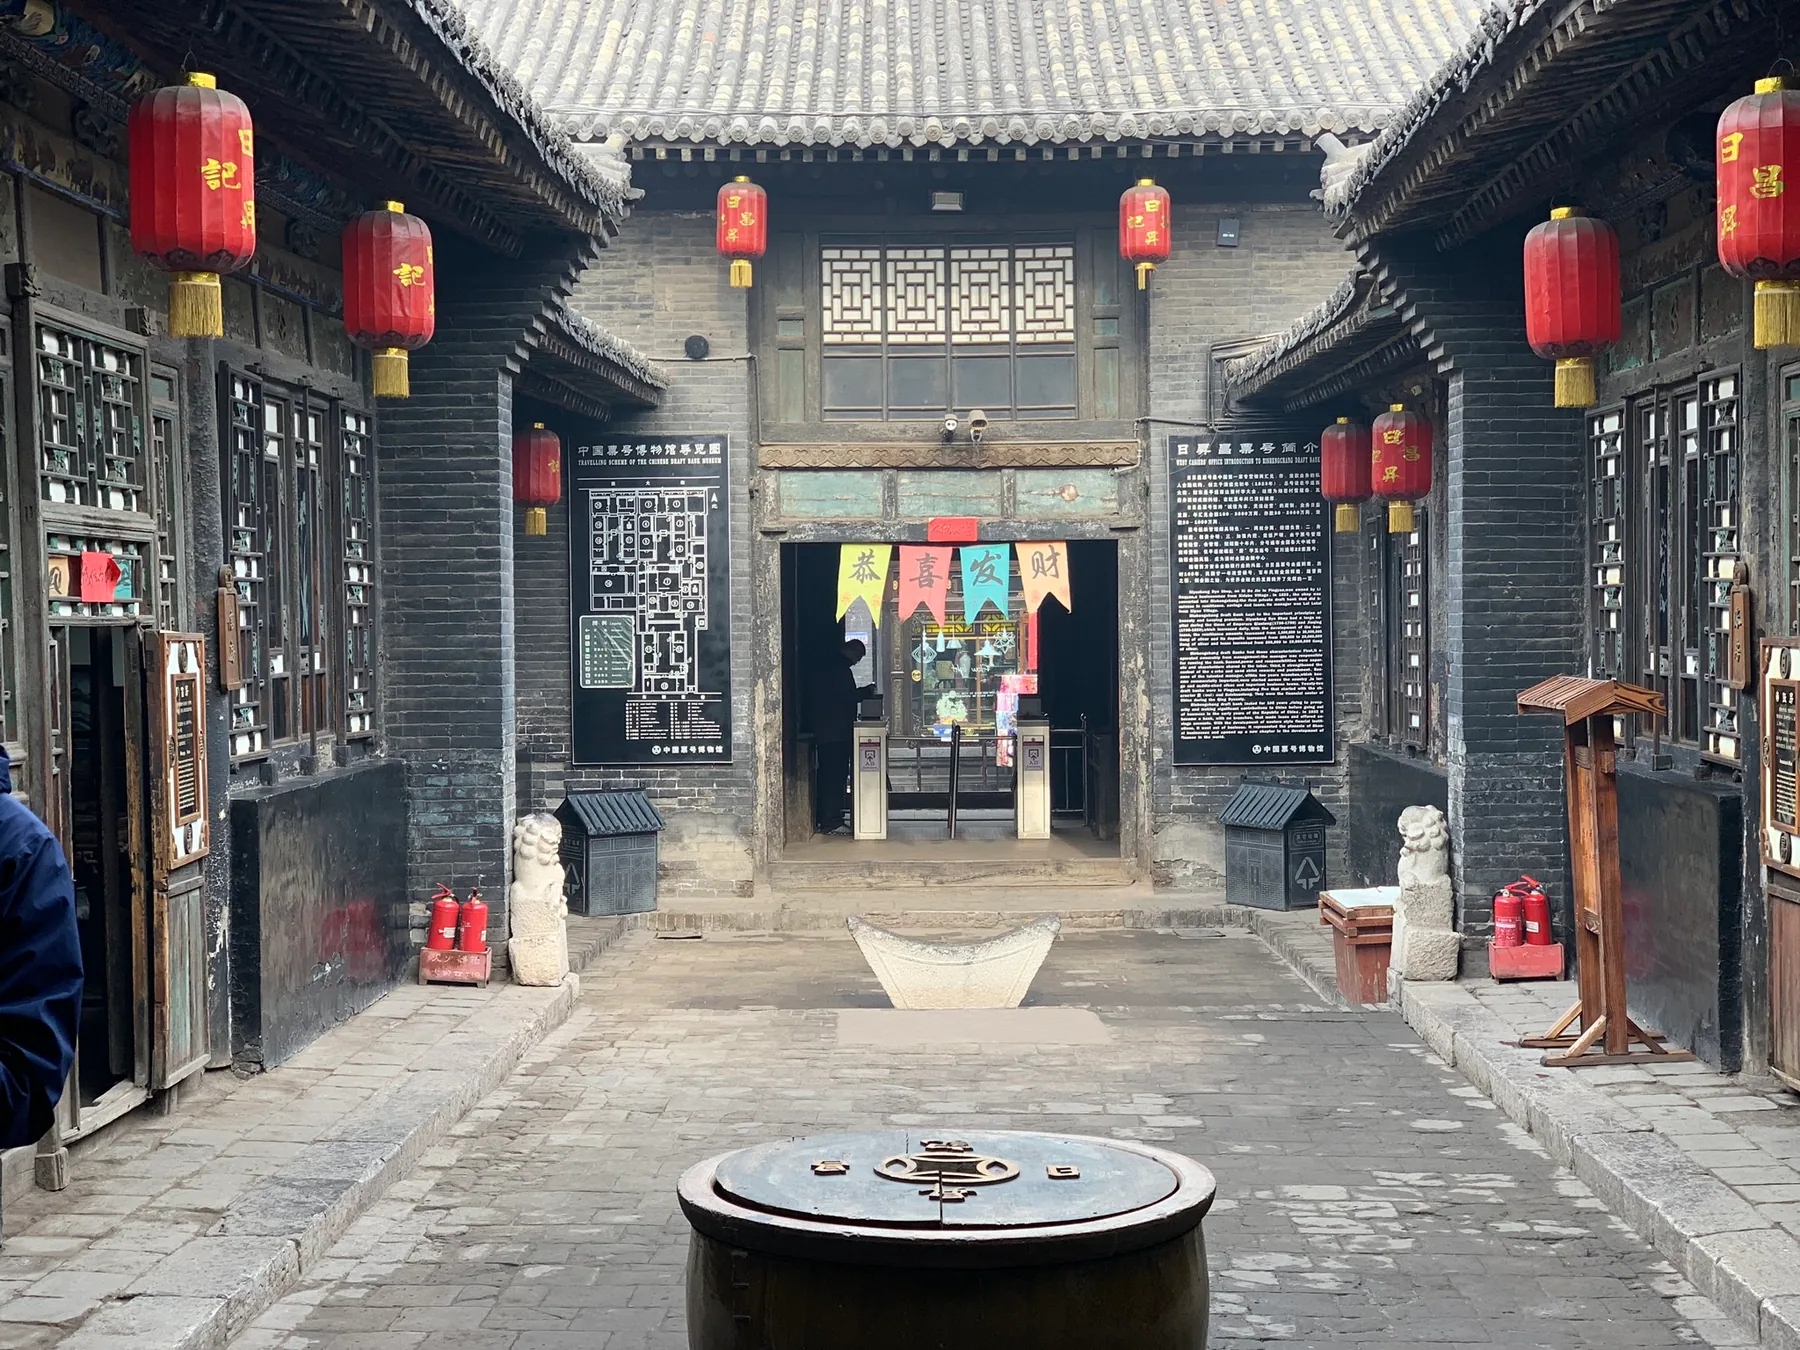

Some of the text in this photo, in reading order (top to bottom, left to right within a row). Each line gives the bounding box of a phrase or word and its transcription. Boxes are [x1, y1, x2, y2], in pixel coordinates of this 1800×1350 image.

[1721, 132, 1743, 163] 日
[1750, 165, 1785, 199] 昌
[1145, 200, 1160, 213] 日
[578, 443, 721, 456] 中国票号博物馆导览图
